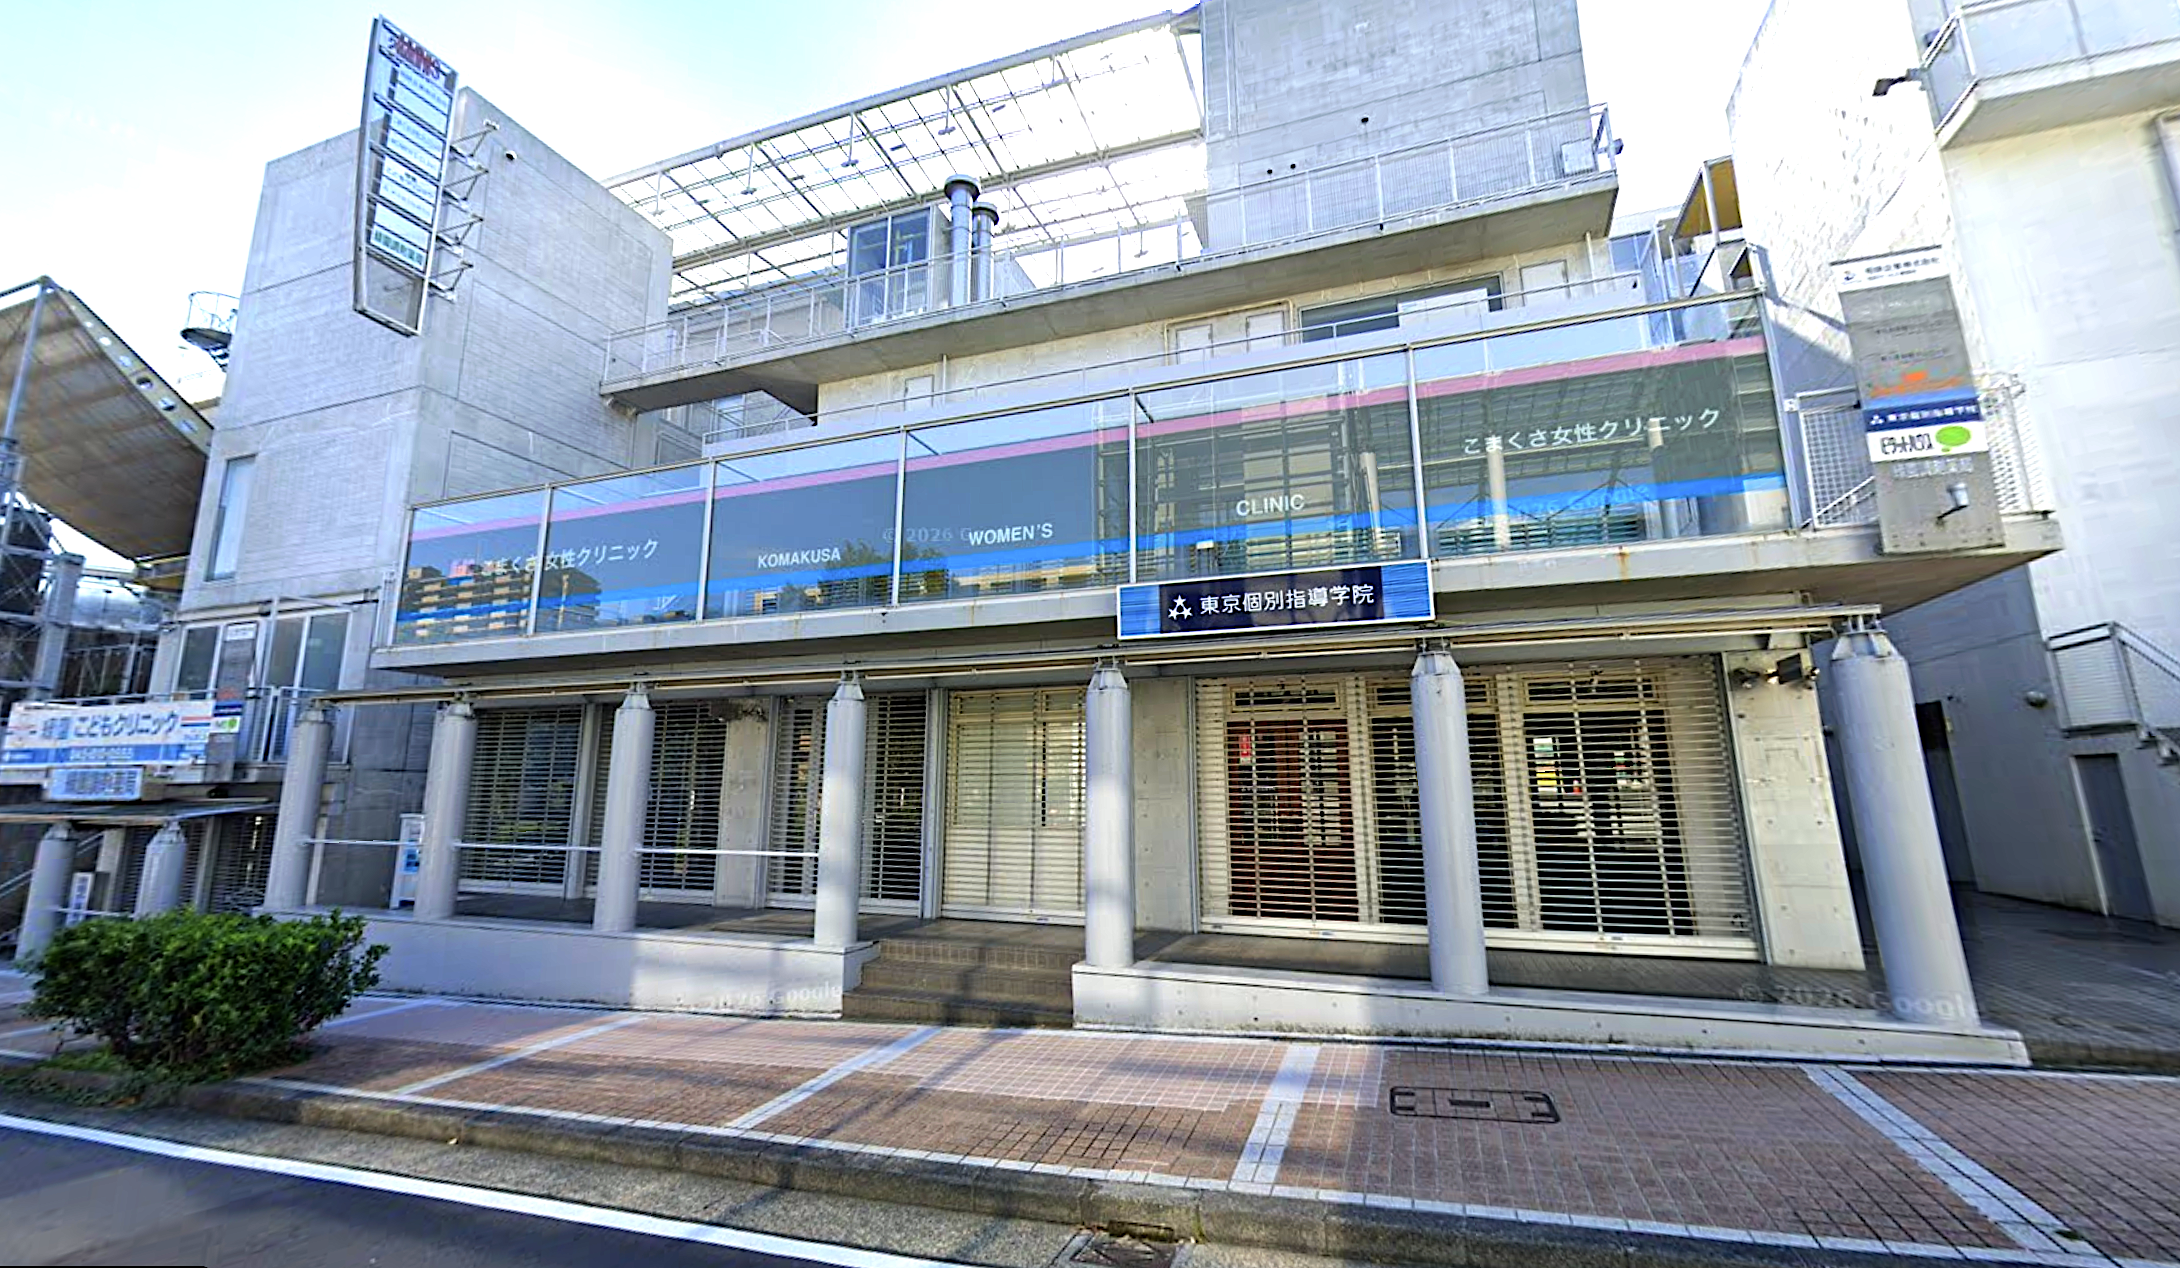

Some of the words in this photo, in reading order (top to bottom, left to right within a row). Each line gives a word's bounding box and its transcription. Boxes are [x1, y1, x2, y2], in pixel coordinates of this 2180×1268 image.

[1463, 408, 1720, 454] こまくさ女性クリニック
[1236, 493, 1305, 517] CLINIC
[968, 522, 1053, 546] WOMEN'S
[481, 539, 659, 577] こまくさ女性クリニック
[757, 547, 842, 569] KOMAKUSA
[1199, 584, 1375, 616] 東京個別指導学院
